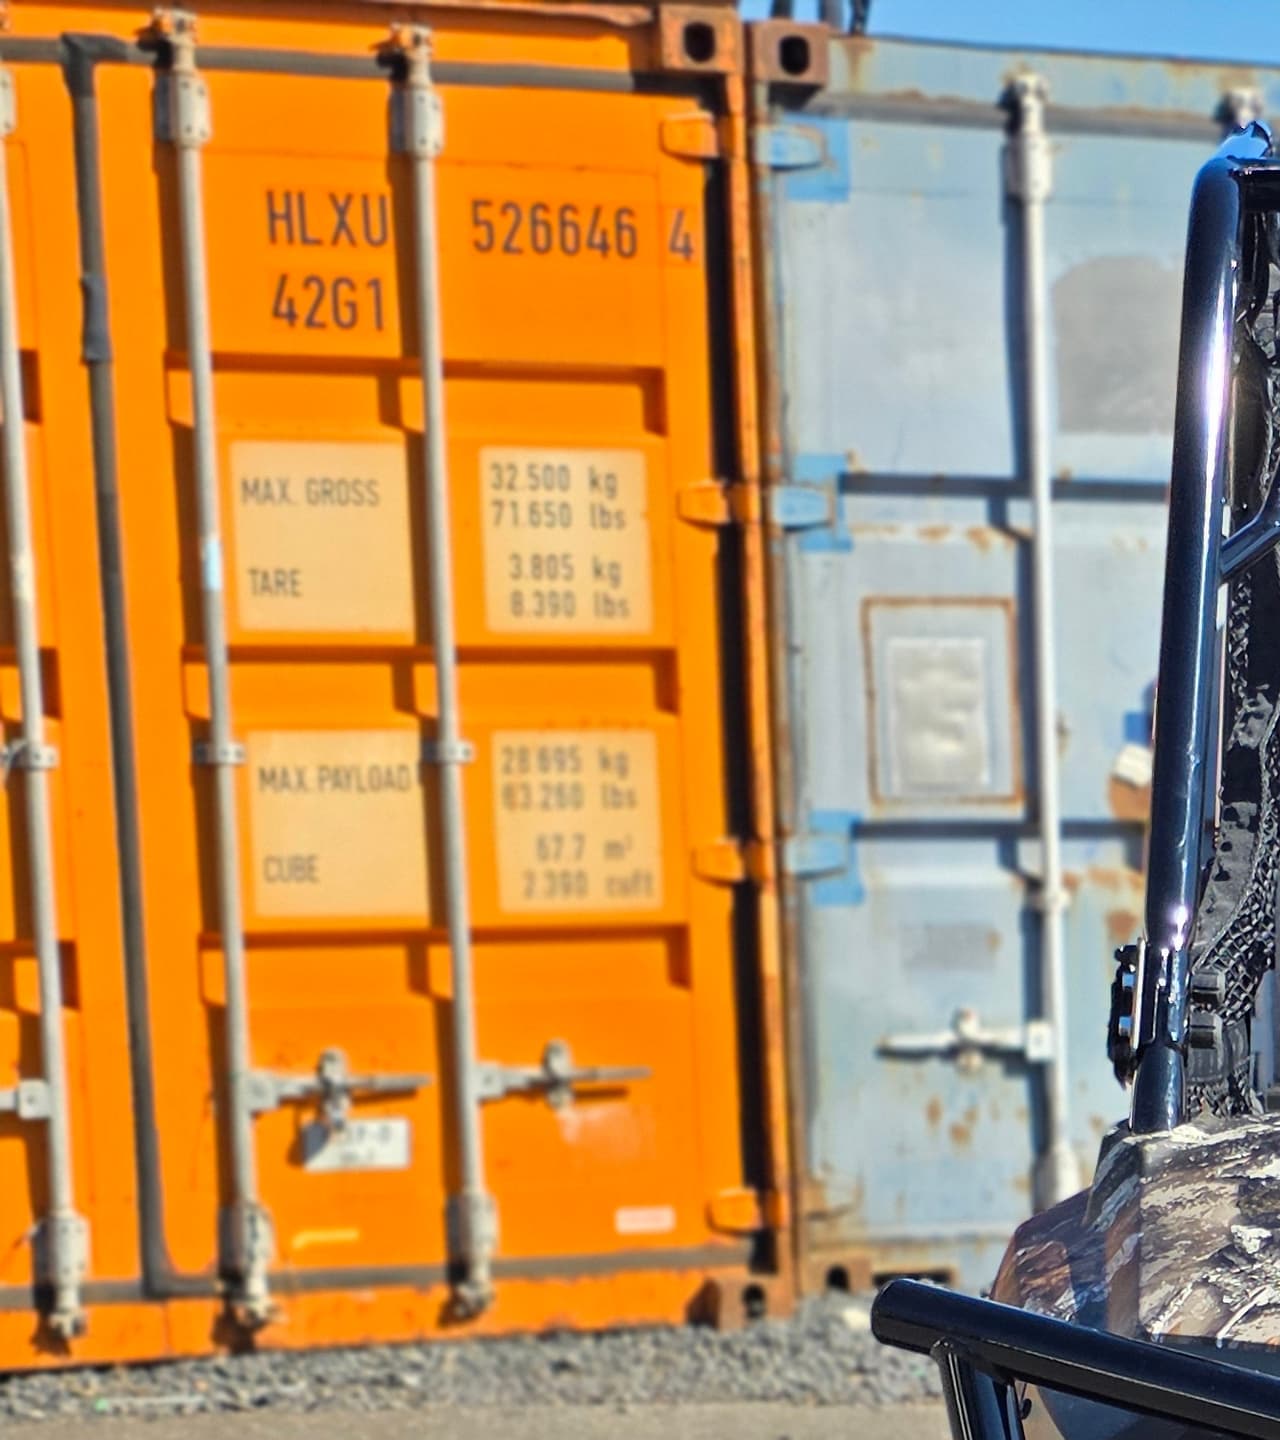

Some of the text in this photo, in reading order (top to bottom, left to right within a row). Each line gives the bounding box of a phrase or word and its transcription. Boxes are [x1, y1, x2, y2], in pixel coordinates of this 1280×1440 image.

[266, 190, 695, 263] HLXU 526646 4
[272, 273, 384, 331] 42G1
[305, 477, 380, 508] GROSS
[490, 462, 618, 501] 32.500 kg
[589, 502, 627, 531] lbs
[248, 567, 302, 597] TARE
[592, 556, 621, 589] kg
[593, 590, 630, 619] lbs
[598, 745, 629, 780] kg
[317, 763, 411, 793] PAYLOAD
[601, 782, 637, 811] lbs
[263, 854, 320, 884] CUBE
